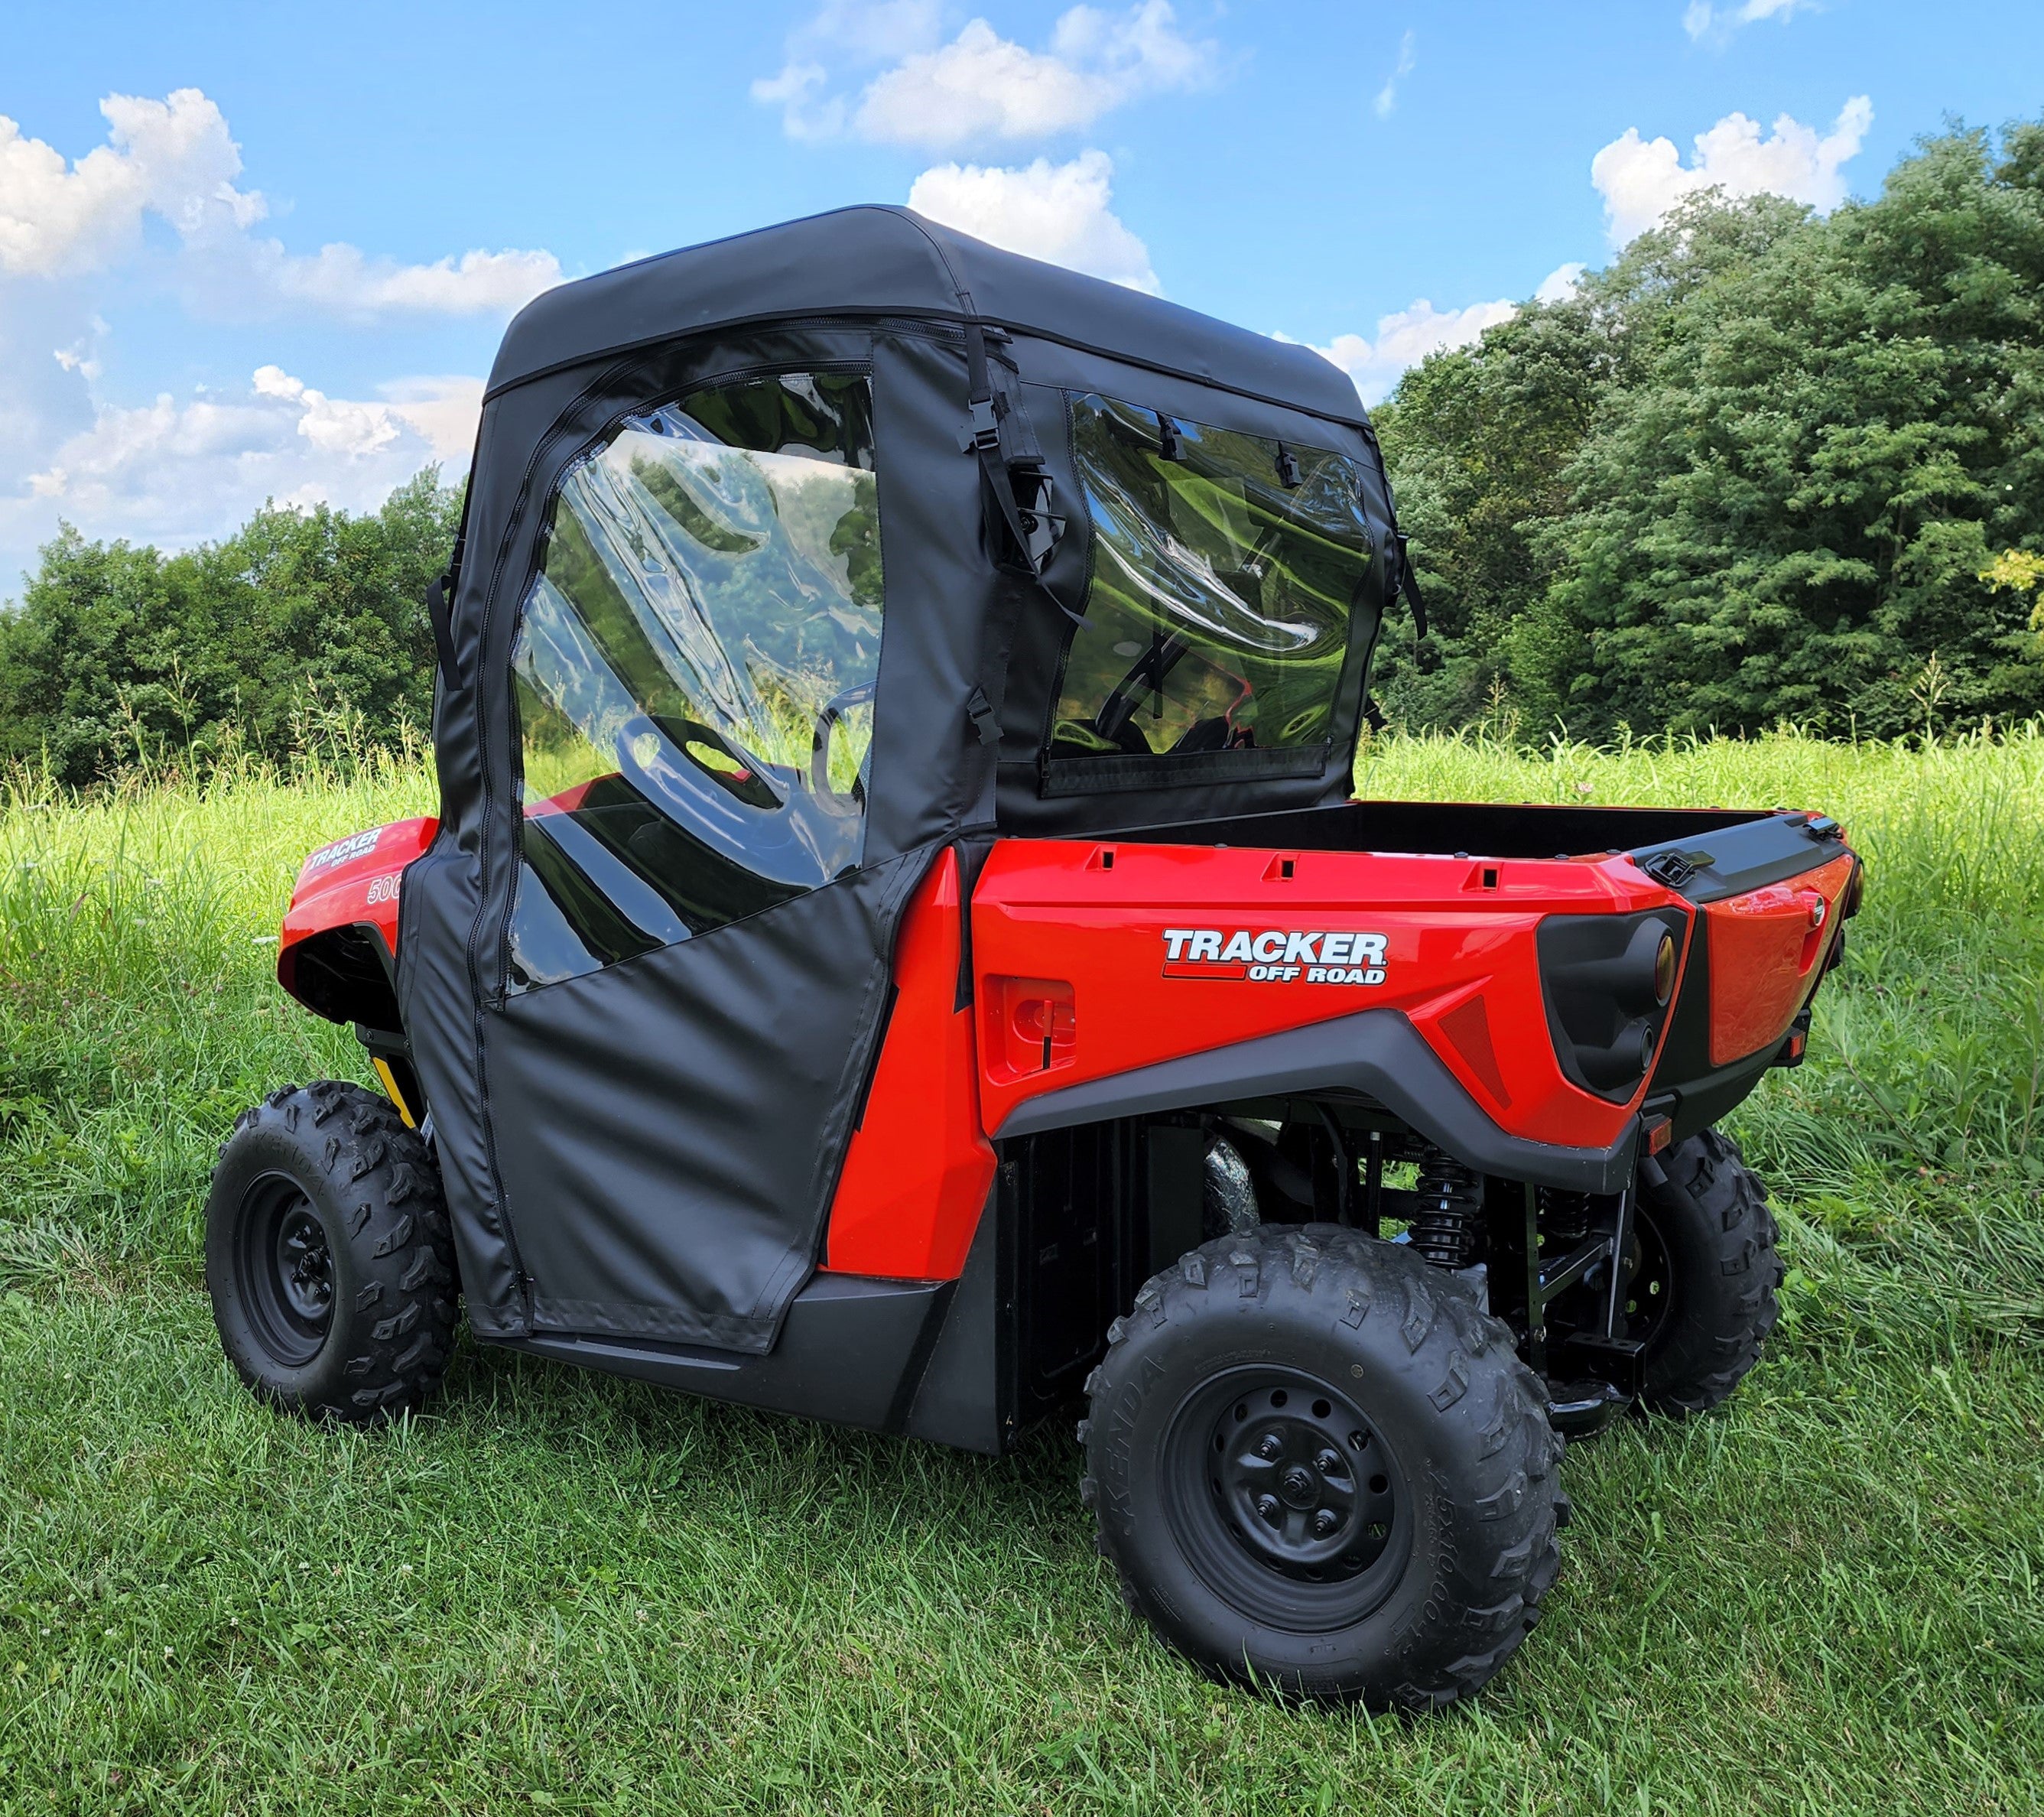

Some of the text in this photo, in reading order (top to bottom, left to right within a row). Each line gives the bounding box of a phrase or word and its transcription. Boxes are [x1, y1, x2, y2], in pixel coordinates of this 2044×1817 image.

[309, 827, 383, 870] TRACKER
[330, 844, 376, 867] OFF ROAD
[1163, 929, 1389, 965] TRACKER
[1249, 965, 1386, 986] OFF ROAD
[1104, 1354, 1168, 1526] KENDA
